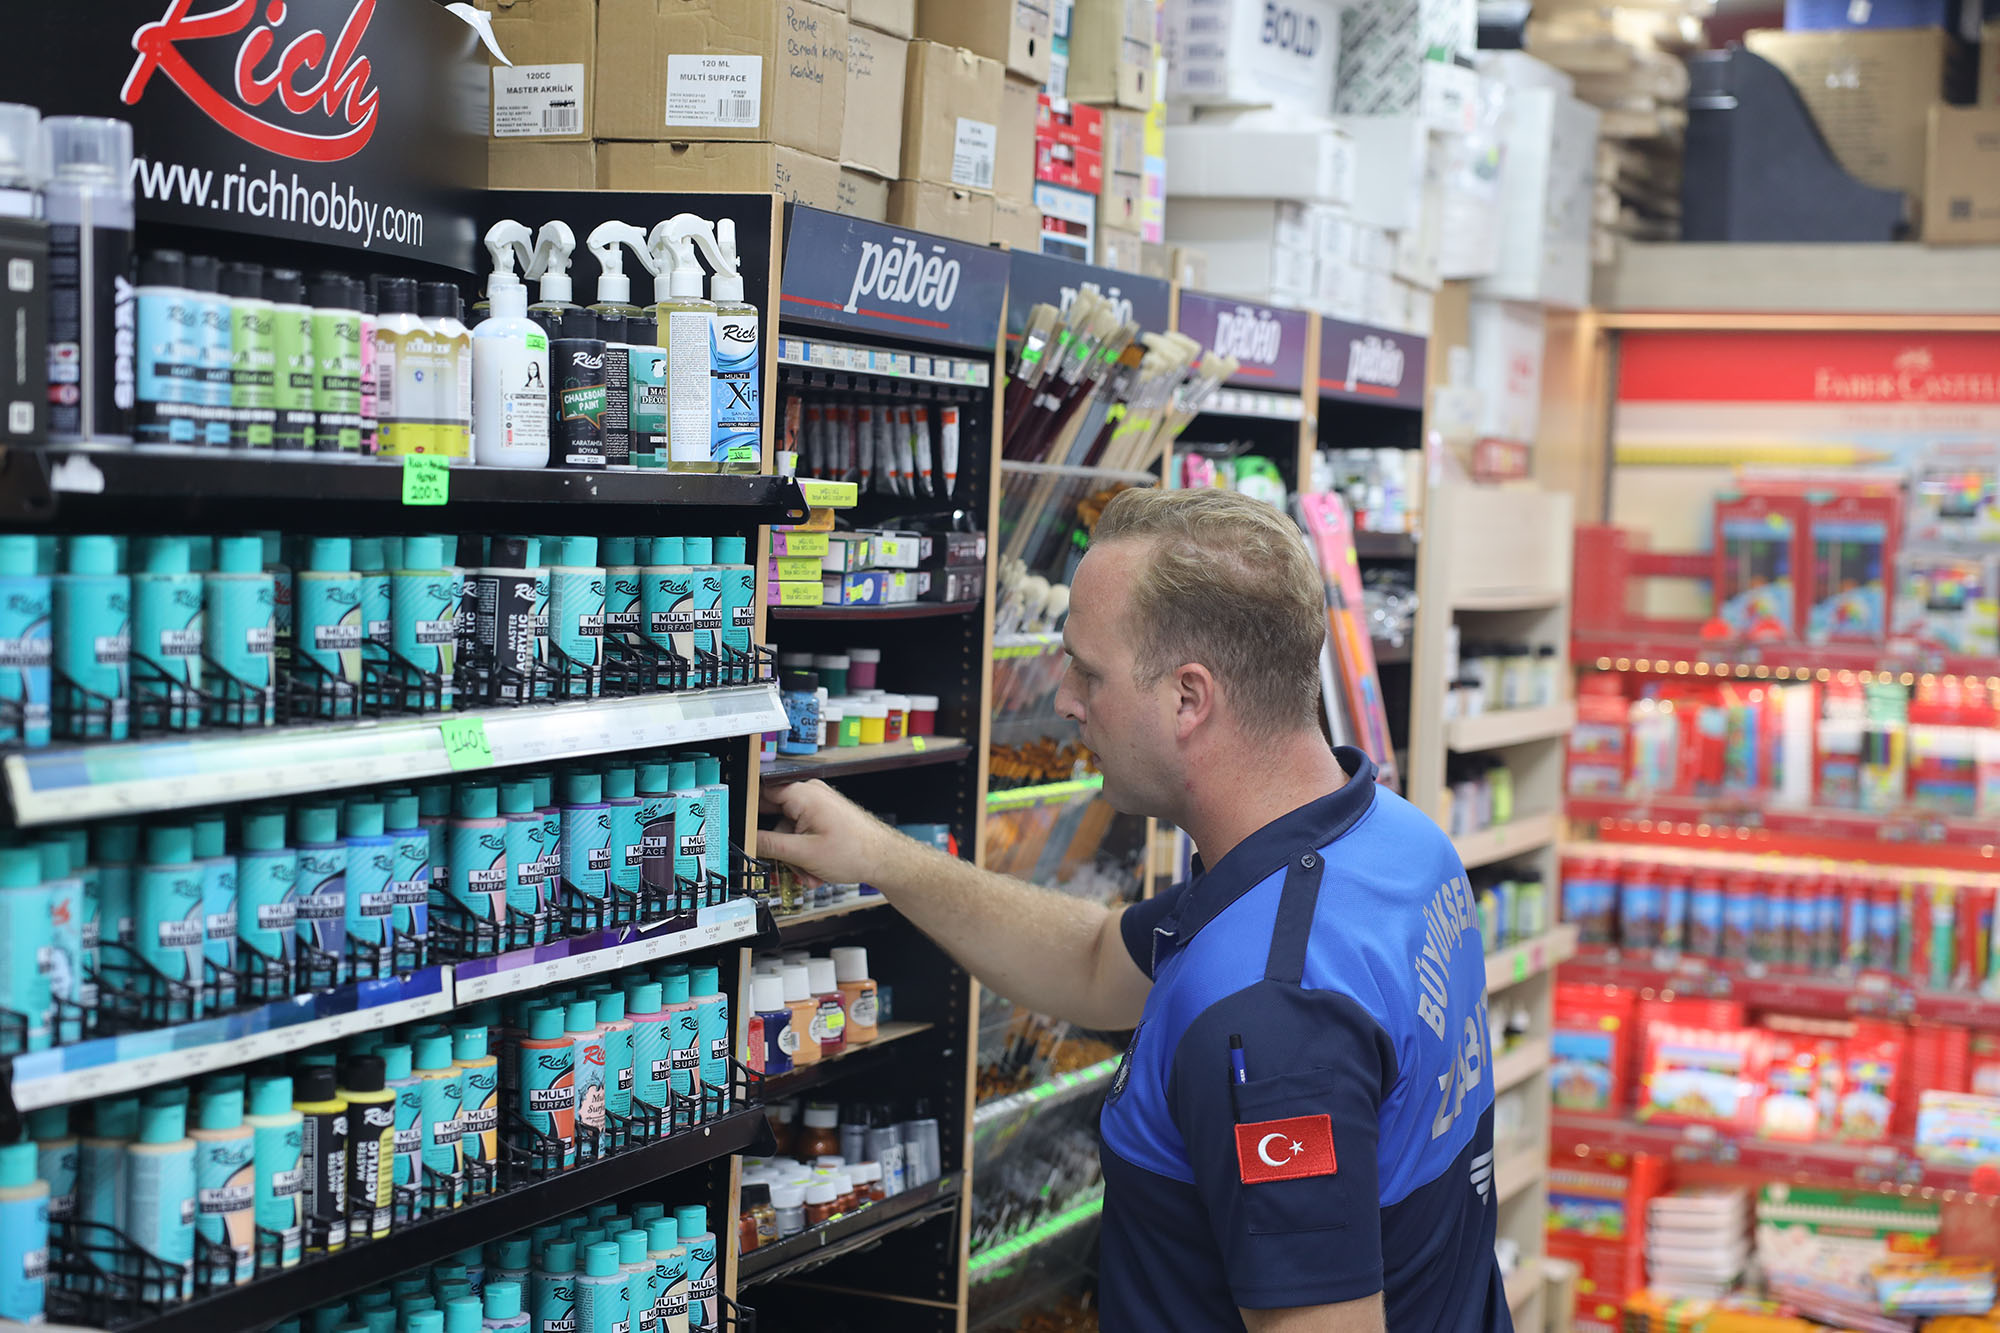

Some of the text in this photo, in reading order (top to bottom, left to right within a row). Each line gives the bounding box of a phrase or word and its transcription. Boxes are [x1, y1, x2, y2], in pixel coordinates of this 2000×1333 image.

[526, 72, 551, 80] 120CC
[707, 74, 747, 82] SURFACE
[507, 84, 573, 94] MASTER AKRİLİK
[723, 324, 756, 343] Rich
[572, 351, 604, 369] Rich
[578, 400, 600, 411] PAINT
[659, 579, 688, 595] Rich
[659, 613, 691, 622] MULTI
[508, 614, 518, 650] MASTER
[516, 613, 529, 671] ACRYLIC
[301, 856, 335, 874] Rich
[538, 1053, 569, 1070] Rich
[538, 1088, 572, 1100] MULTI
[356, 1141, 368, 1182] MASTER
[365, 1140, 379, 1203] ACRYLIC
[656, 1305, 687, 1317] URFACE
